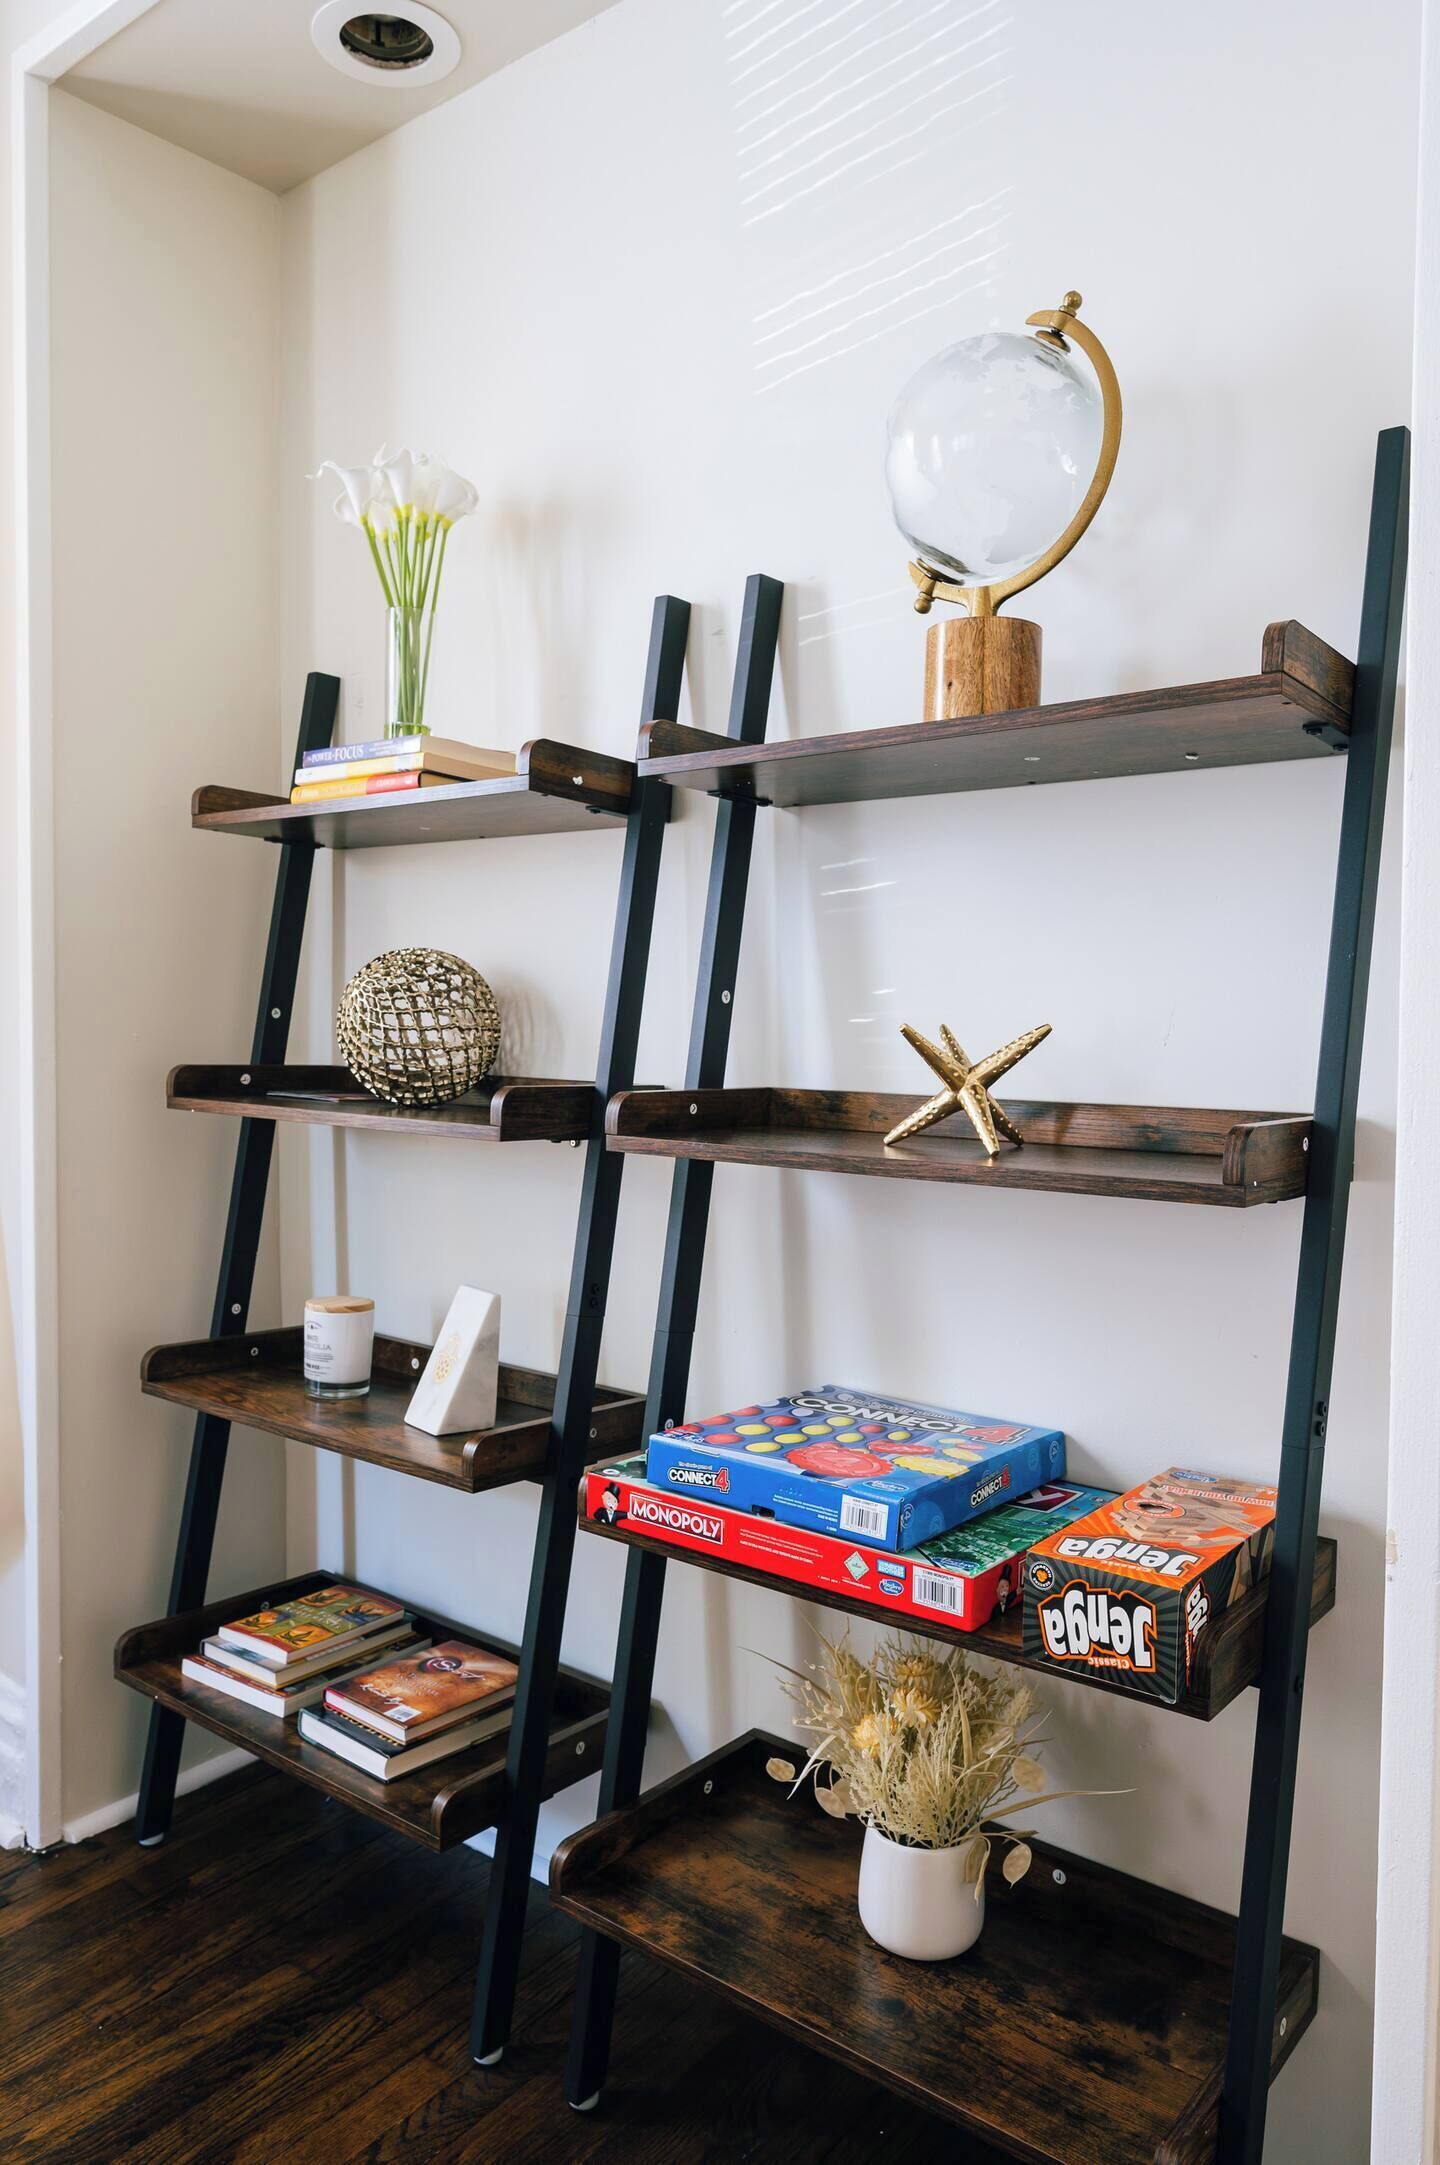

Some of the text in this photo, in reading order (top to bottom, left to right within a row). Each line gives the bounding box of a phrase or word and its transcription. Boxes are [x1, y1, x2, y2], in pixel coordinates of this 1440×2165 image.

[334, 744, 364, 761] FOCUS
[798, 1396, 976, 1433] CONNECT
[963, 1424, 1027, 1446] 4
[669, 1468, 729, 1492] CONNECT 4
[970, 1477, 1003, 1507] CONNECT
[1001, 1466, 1011, 1489] 4
[632, 1499, 721, 1538] MONOPOLY
[1058, 1536, 1201, 1577] Jenga
[1042, 1589, 1153, 1668] Jenga
[1088, 1656, 1130, 1670] Classic
